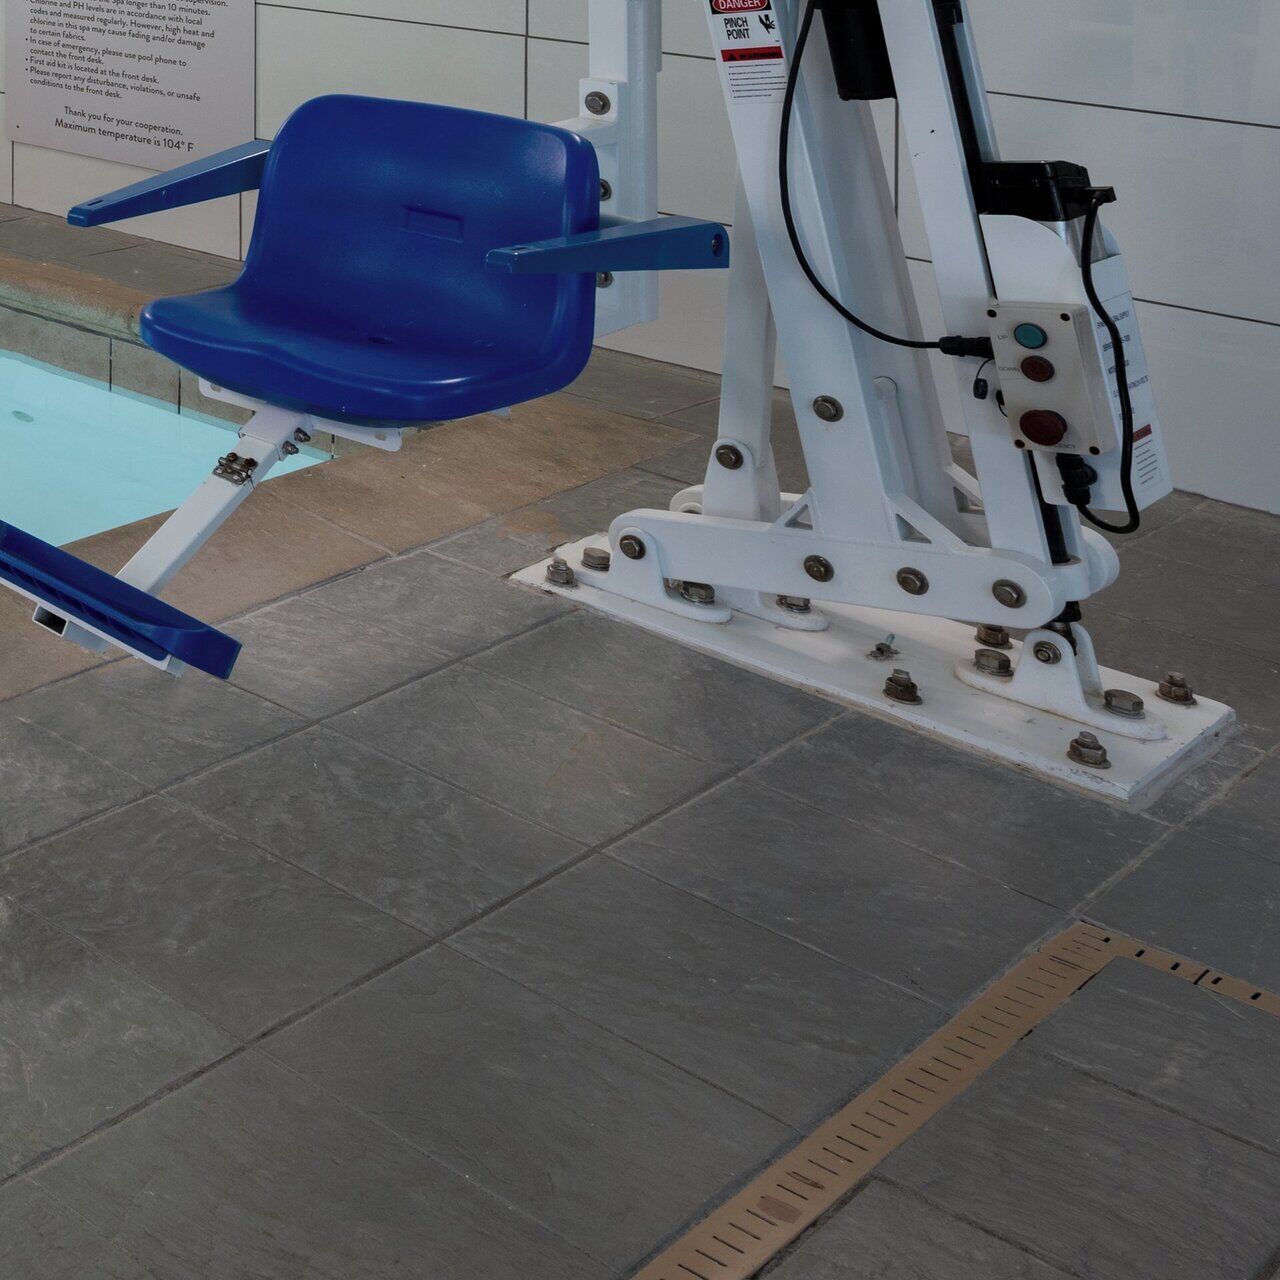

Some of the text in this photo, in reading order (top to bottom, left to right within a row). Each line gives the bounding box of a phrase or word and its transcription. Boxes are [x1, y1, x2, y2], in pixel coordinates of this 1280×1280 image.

[149, 1, 166, 10] than
[168, 3, 177, 11] 10
[178, 6, 210, 15] minutes.
[724, 17, 749, 28] PINCH
[726, 29, 750, 40] POINT
[29, 57, 45, 66] First
[46, 60, 56, 68] aid
[57, 61, 66, 69] kit
[74, 64, 98, 74] located
[108, 69, 120, 78] the
[121, 71, 140, 81] front
[141, 74, 159, 84] desk.
[29, 79, 122, 99] conditions to the front desk.
[64, 106, 86, 118] Thank
[103, 113, 114, 122] for
[115, 117, 133, 126] your
[134, 121, 183, 134] cooperation.
[54, 119, 96, 134] Maximum
[98, 127, 152, 144] temperature
[153, 137, 162, 146] is
[187, 142, 194, 151] F
